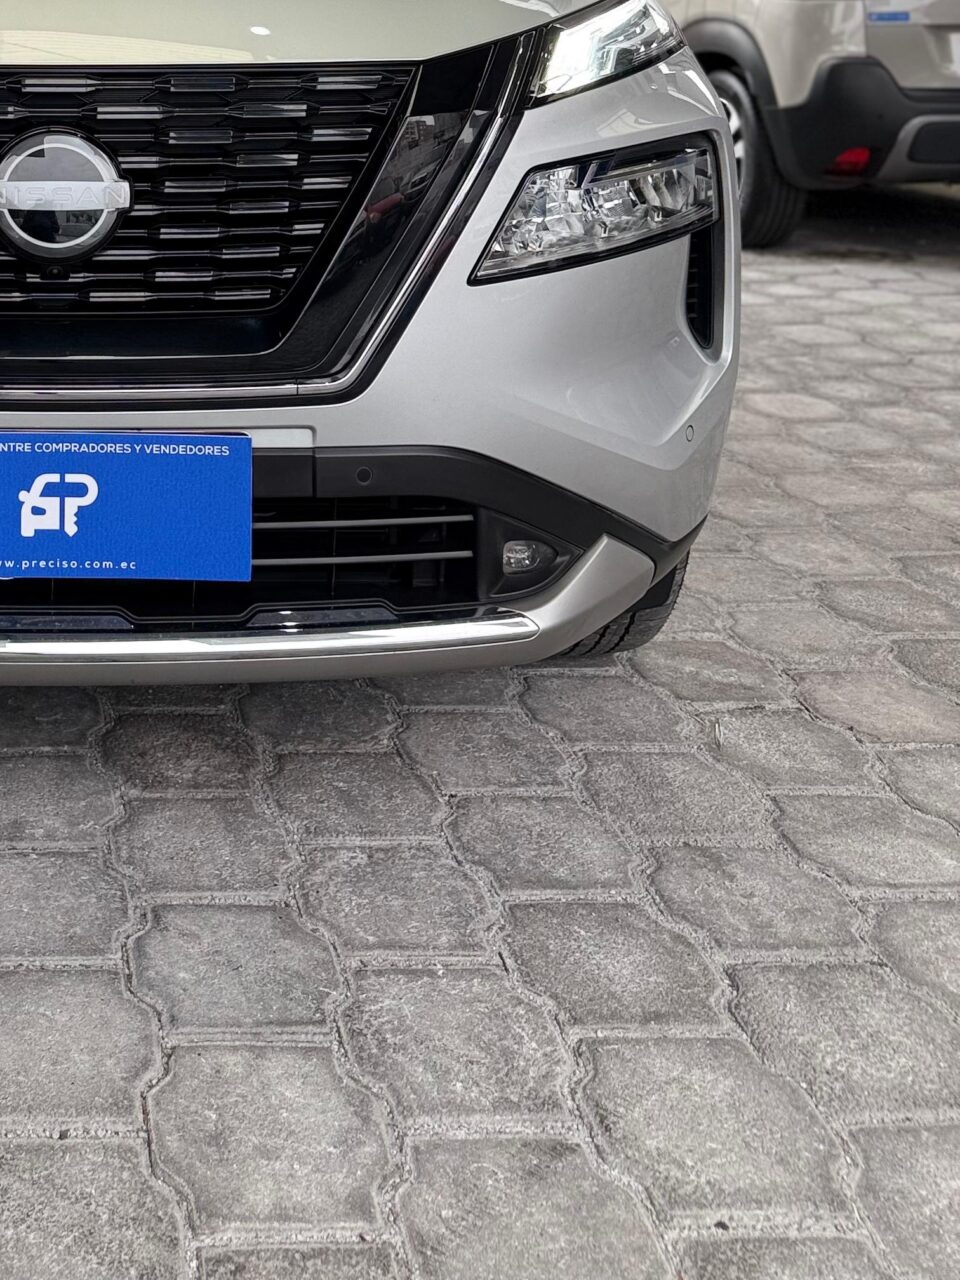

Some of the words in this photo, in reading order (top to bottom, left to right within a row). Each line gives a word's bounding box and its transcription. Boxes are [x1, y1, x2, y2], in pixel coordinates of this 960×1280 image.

[34, 442, 131, 454] COMPRADORES
[134, 443, 142, 454] Y
[144, 444, 230, 456] VENDEDORES
